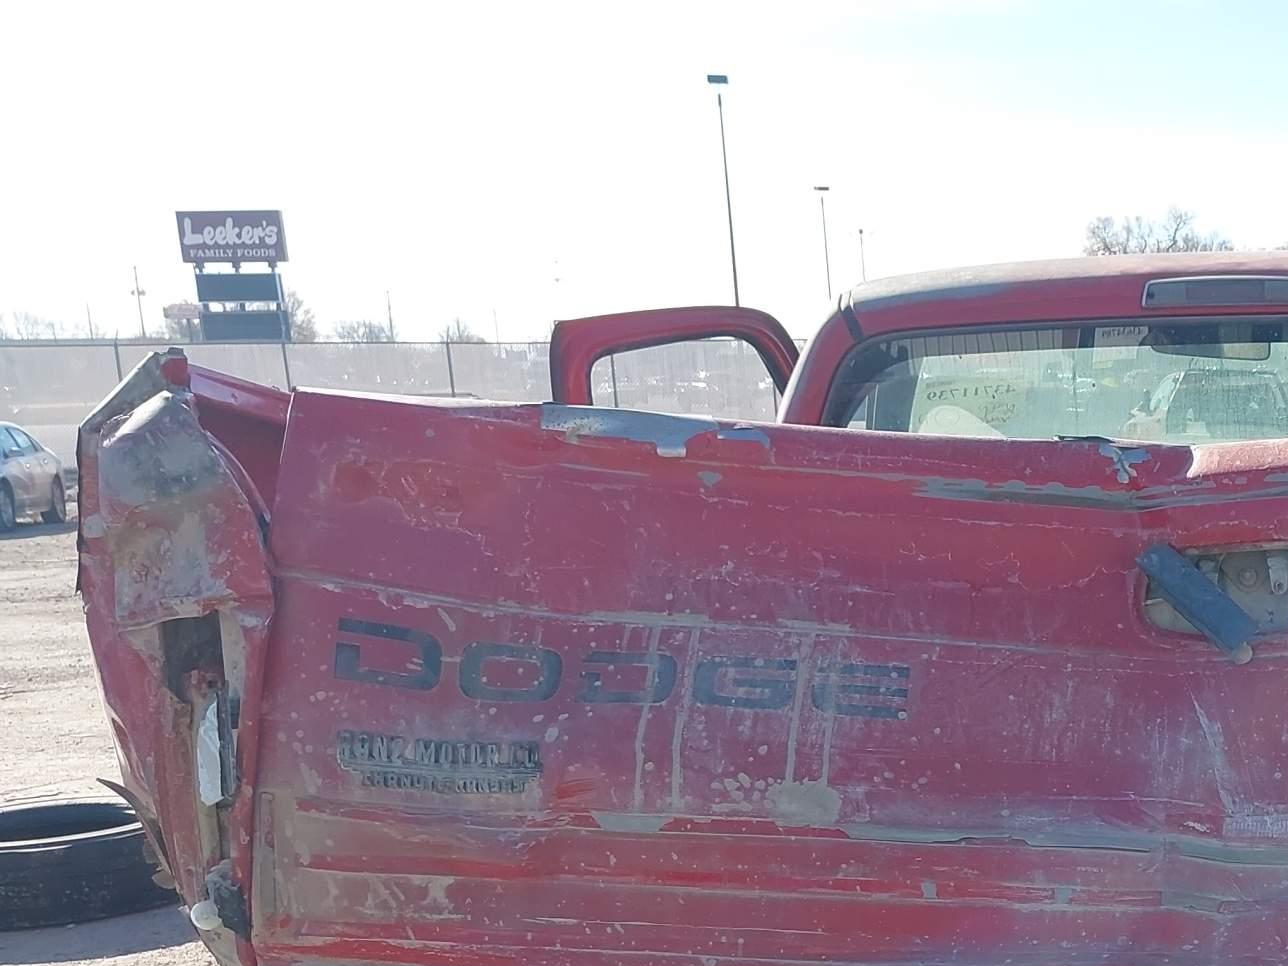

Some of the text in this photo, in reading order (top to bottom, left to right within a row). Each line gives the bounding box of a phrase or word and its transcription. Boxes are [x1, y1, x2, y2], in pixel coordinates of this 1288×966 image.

[183, 217, 278, 245] Leeker's
[190, 248, 276, 257] FAMILY FOODS
[334, 617, 910, 721] DODGE
[415, 740, 500, 768] MOTOR
